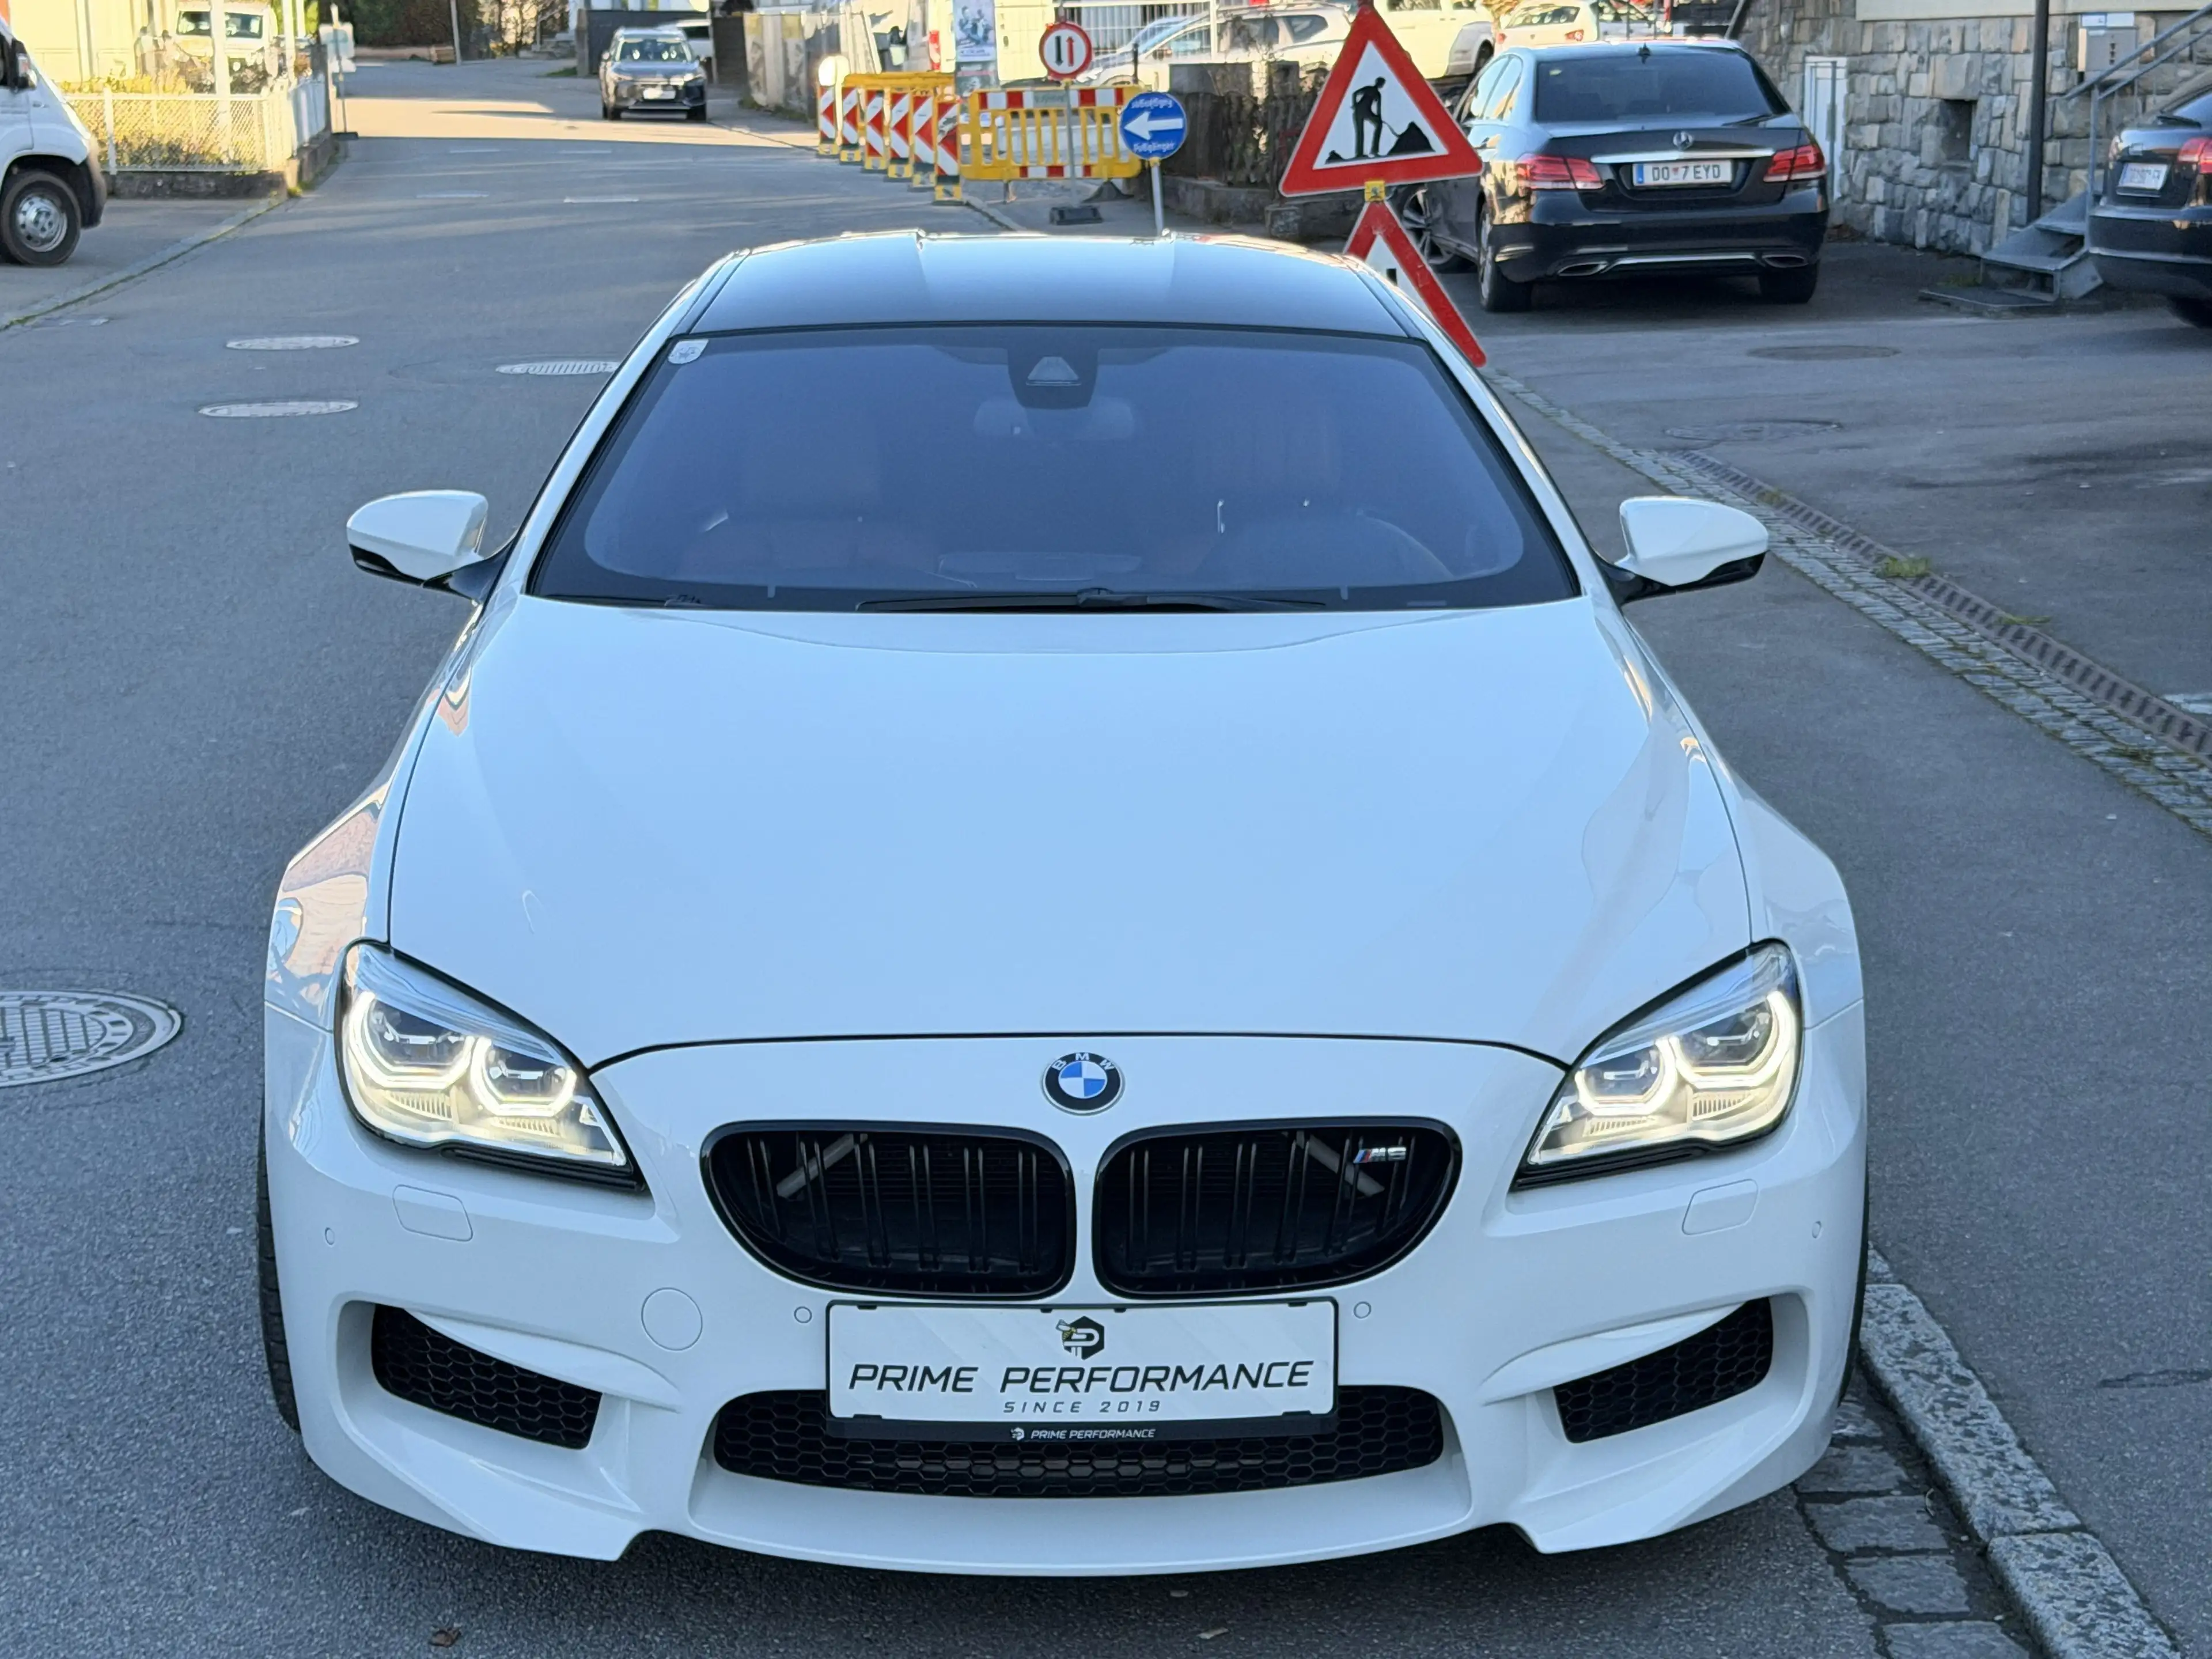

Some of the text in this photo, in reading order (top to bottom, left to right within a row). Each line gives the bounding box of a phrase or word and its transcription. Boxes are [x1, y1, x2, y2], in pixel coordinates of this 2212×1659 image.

[1652, 165, 1670, 181] DO
[1051, 1052, 1115, 1071] BMW
[849, 1361, 1315, 1393] PRIME PERFORMANCE
[1003, 1400, 1161, 1414] SINCE 2019
[1031, 1429, 1157, 1440] PRIME PERFORMANCE
